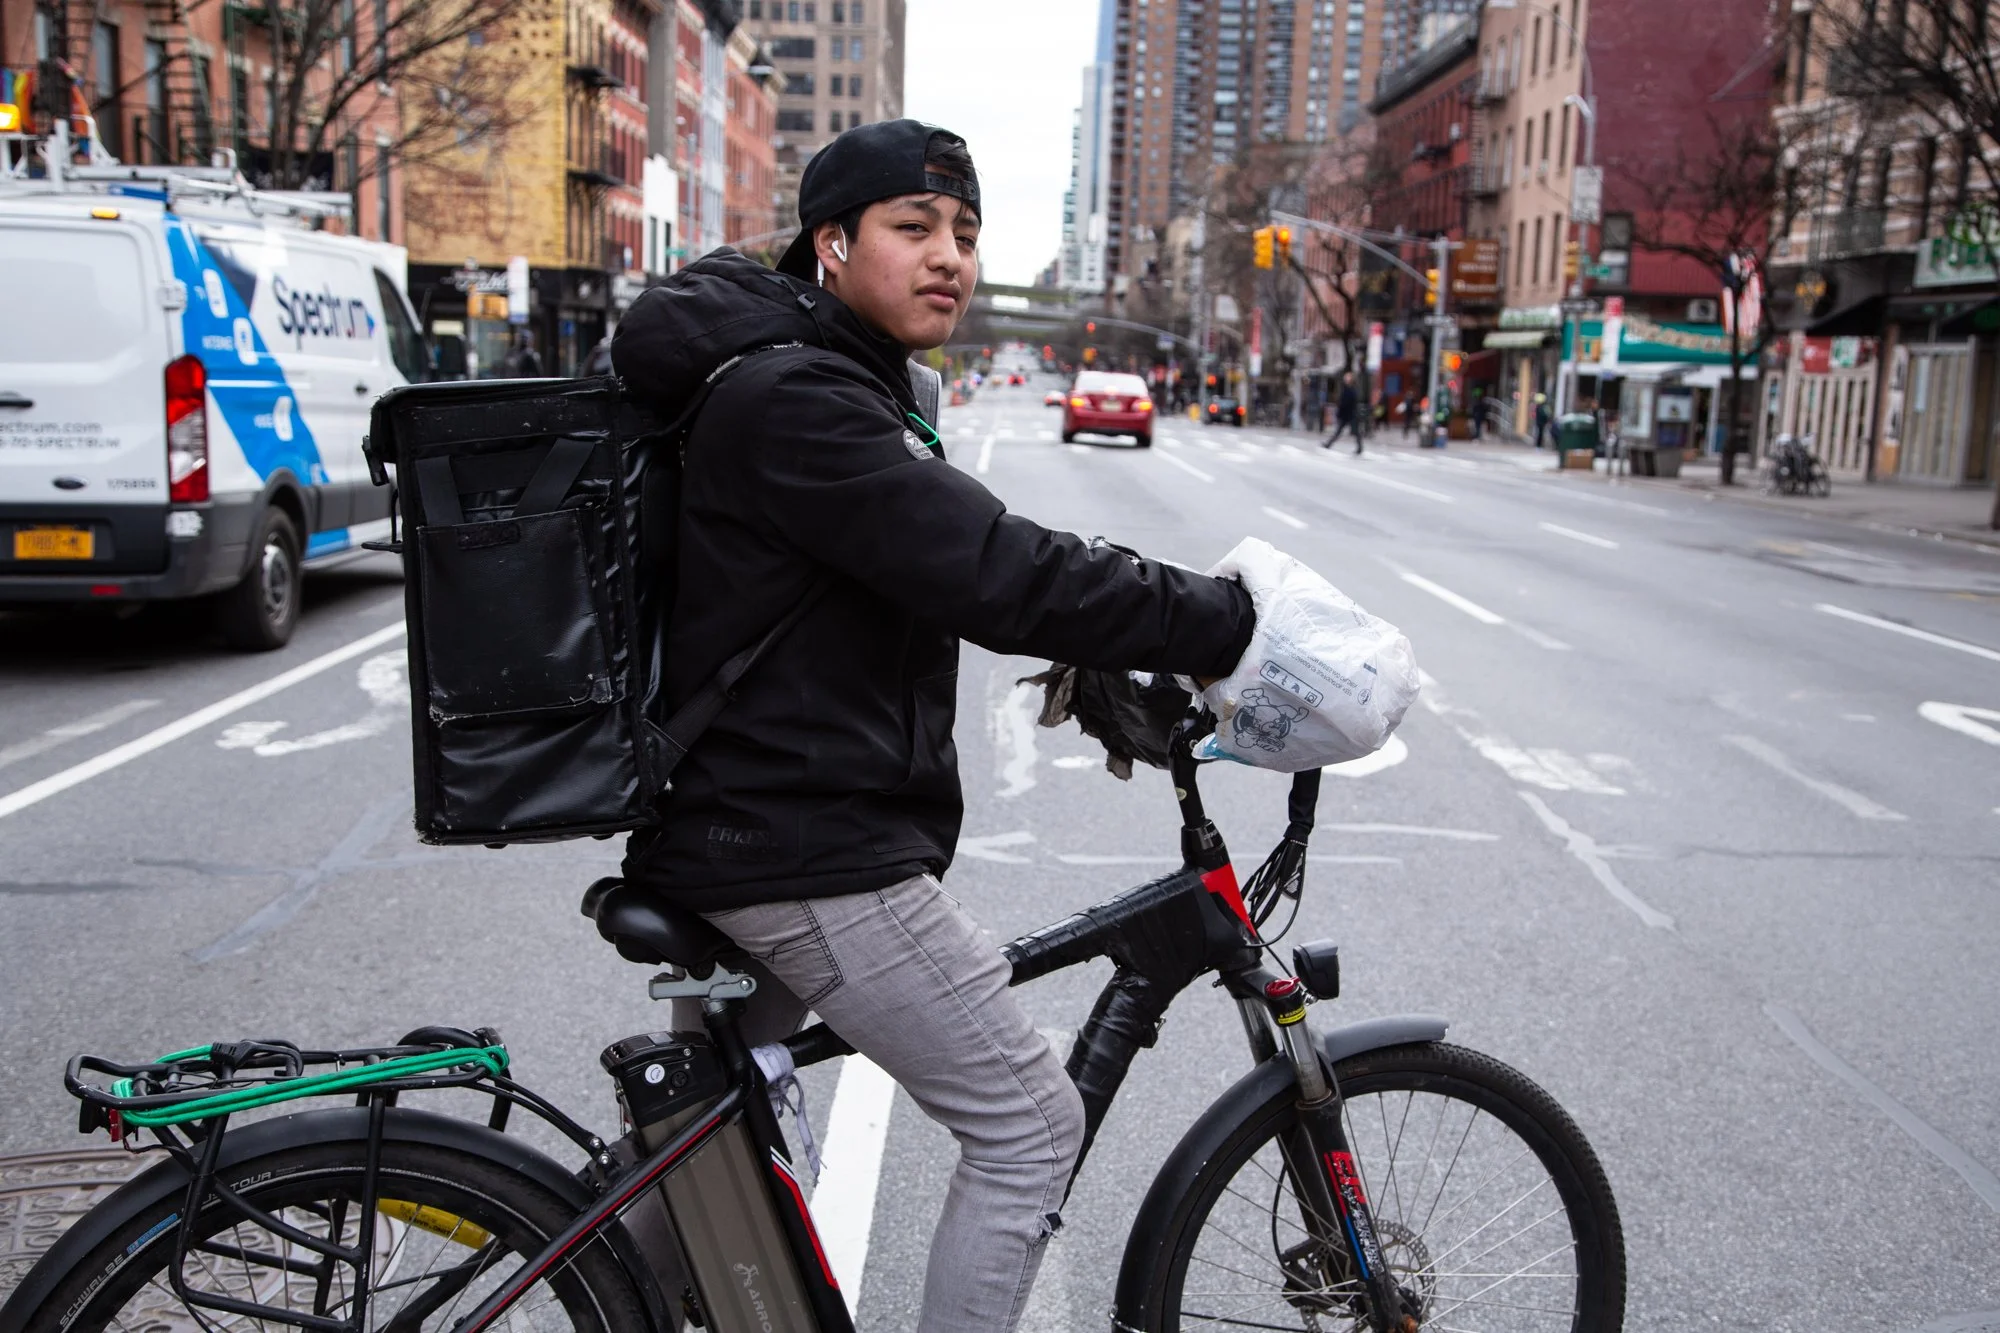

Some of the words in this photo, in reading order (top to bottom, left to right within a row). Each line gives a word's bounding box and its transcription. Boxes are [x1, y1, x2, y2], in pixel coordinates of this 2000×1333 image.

[273, 274, 372, 350] Spectrum
[229, 1171, 271, 1191] TOUR
[59, 1253, 124, 1328] SCHWALBE
